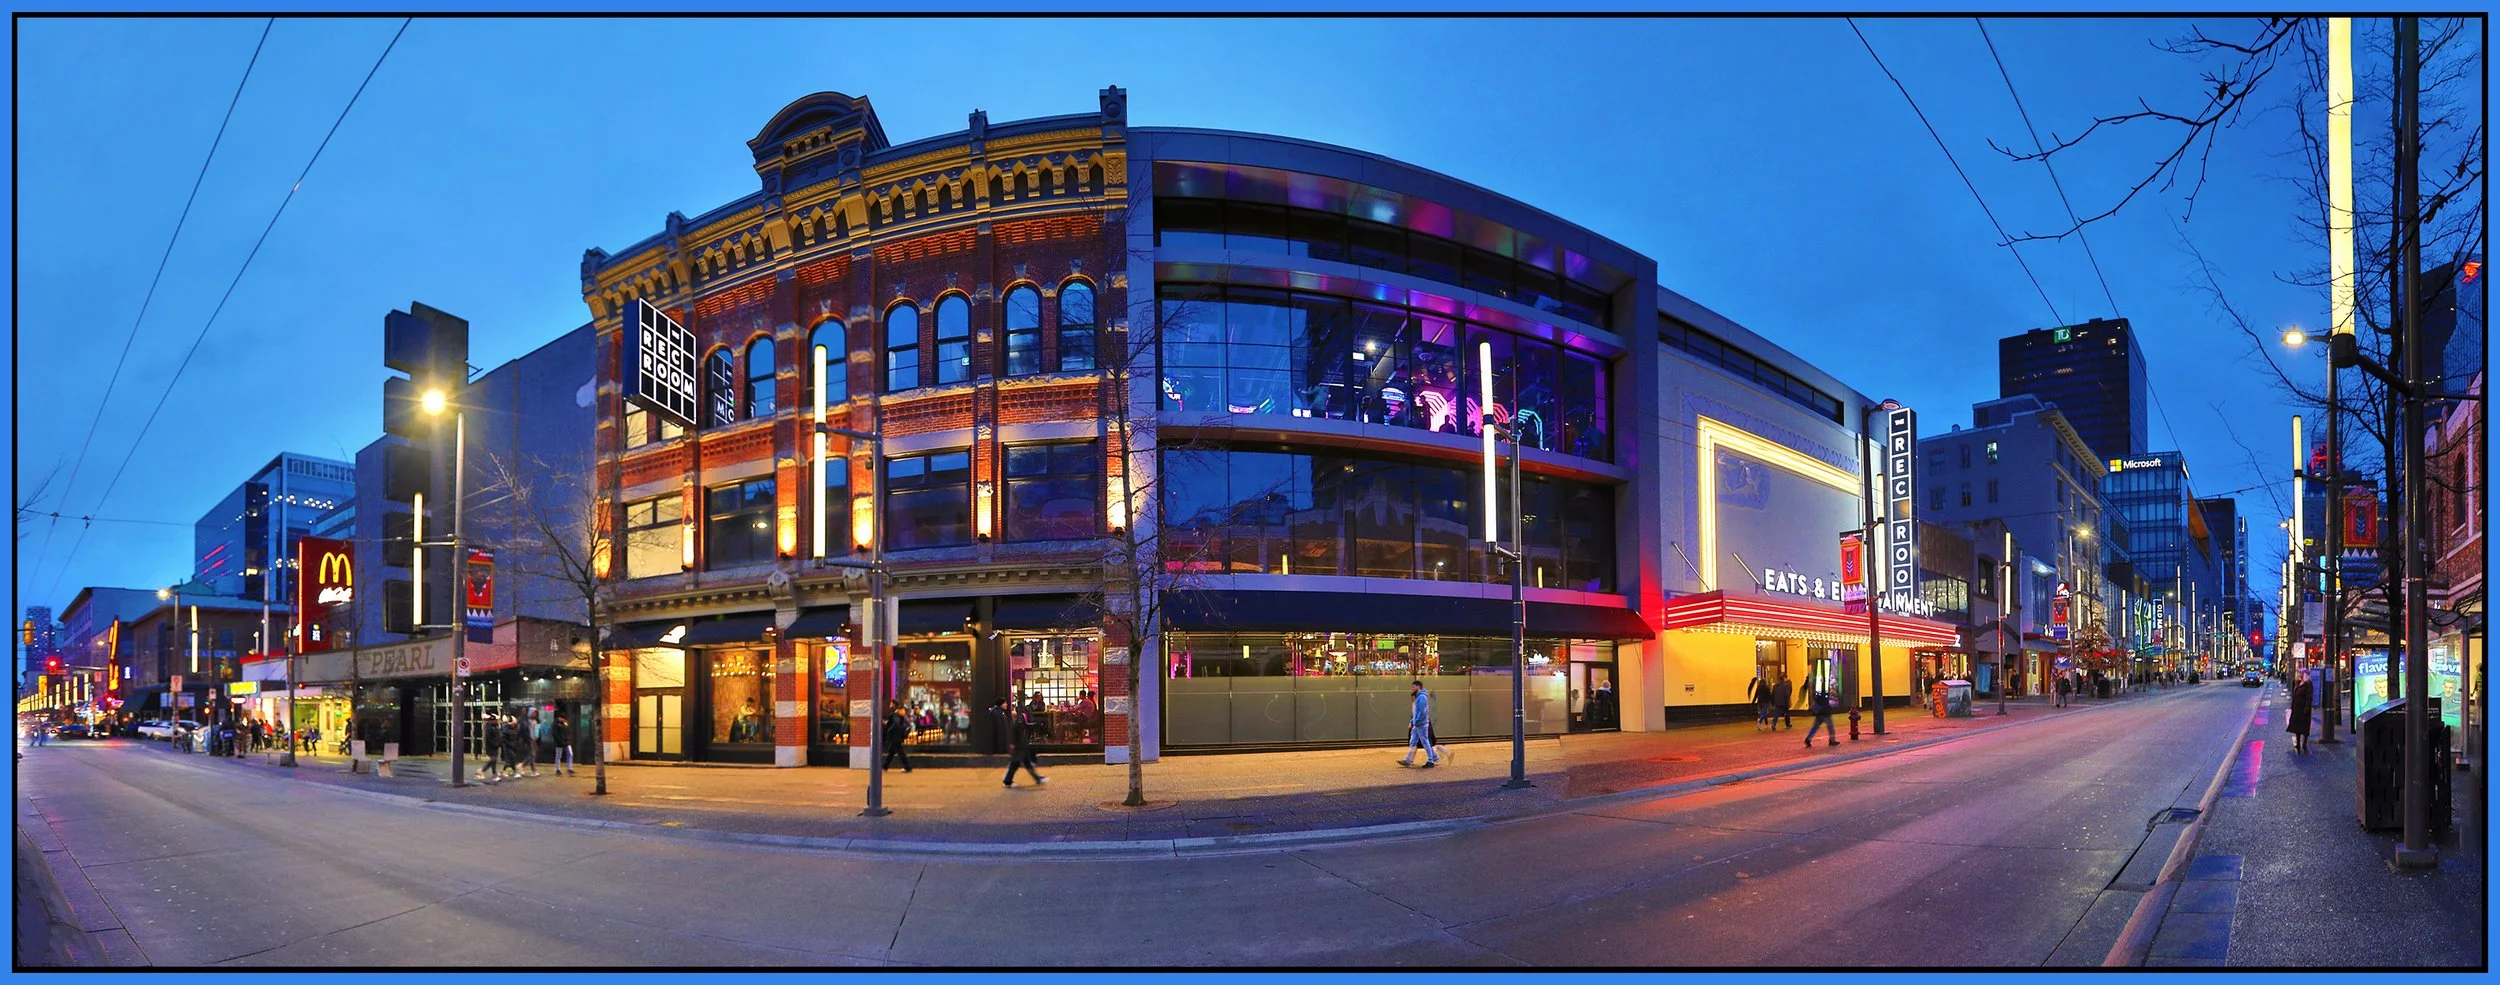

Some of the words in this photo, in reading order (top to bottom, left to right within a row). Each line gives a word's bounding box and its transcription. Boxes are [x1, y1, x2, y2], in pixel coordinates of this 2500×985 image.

[643, 329, 680, 366] REC
[2055, 329, 2070, 341] TD
[643, 352, 694, 397] ROOM
[1895, 437, 1906, 495] REC
[2123, 458, 2162, 470] Microsoft
[1896, 525, 1908, 607] ROOM
[1764, 569, 1808, 595] EATS
[1814, 577, 1826, 599] &
[371, 645, 435, 674] PEARL
[2358, 662, 2405, 674] flavor
